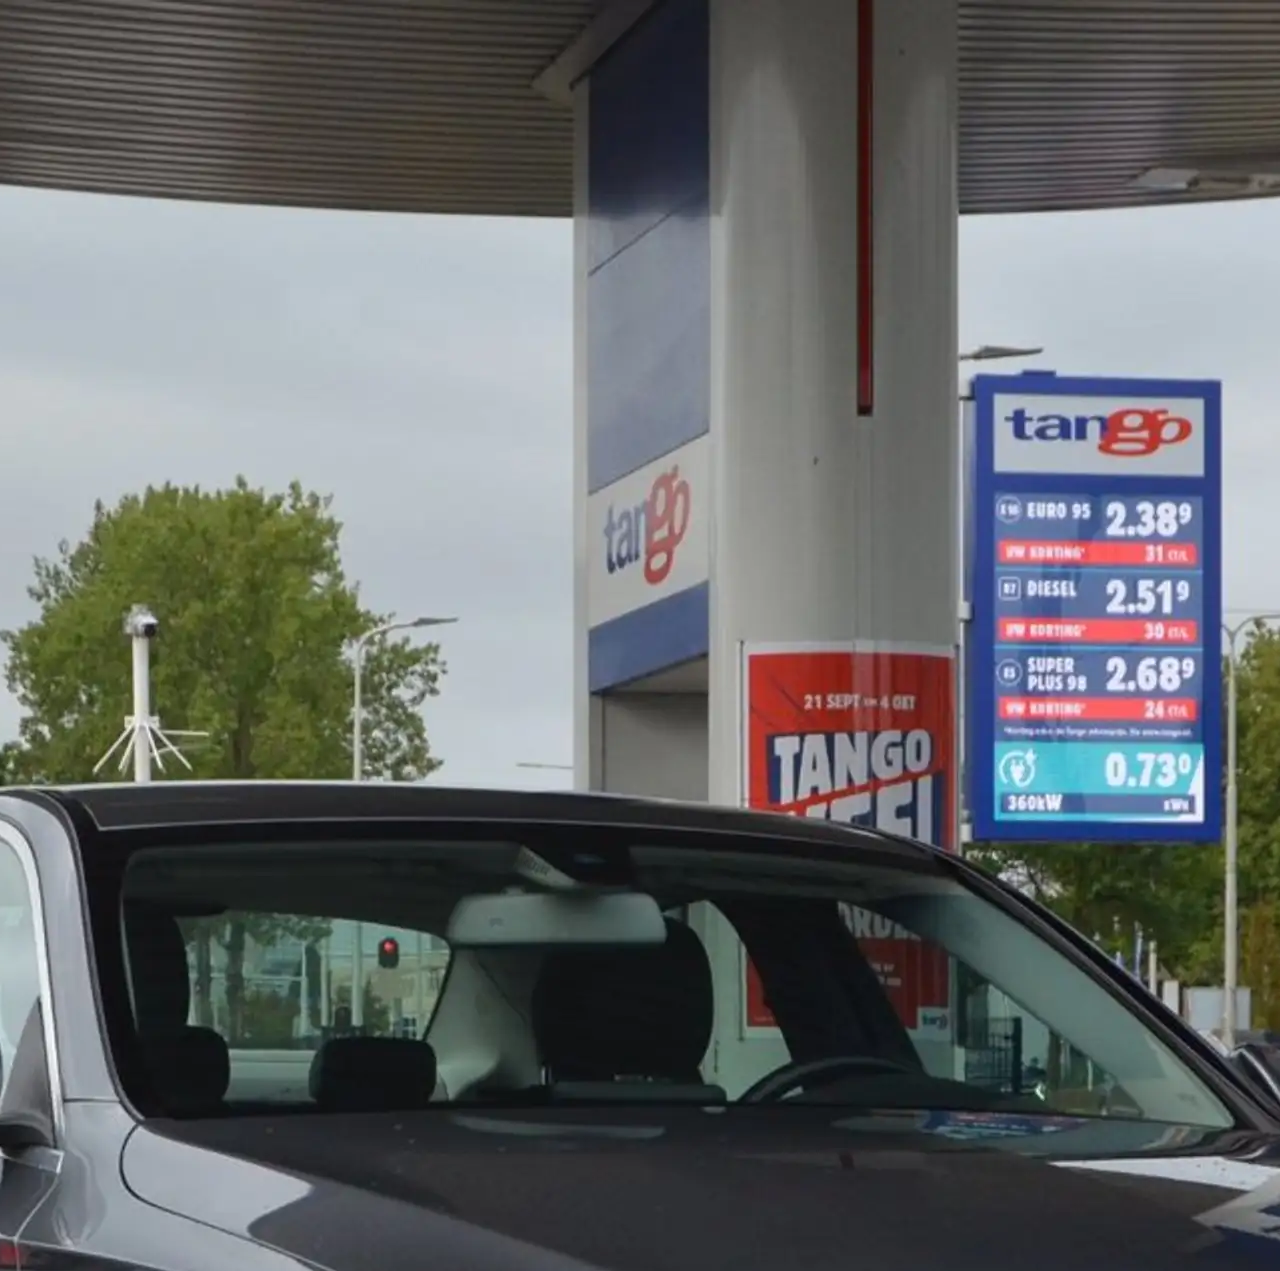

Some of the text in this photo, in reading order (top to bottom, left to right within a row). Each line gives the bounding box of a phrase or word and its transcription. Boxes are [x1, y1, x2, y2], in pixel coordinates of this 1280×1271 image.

[1005, 408, 1193, 457] tango
[1027, 502, 1067, 519] EURO
[1072, 503, 1091, 520] 95
[604, 464, 690, 585] tango
[1027, 580, 1077, 597] DIESEL
[1028, 657, 1074, 673] SUPER
[1028, 676, 1087, 691] PLUS 98
[804, 694, 822, 710] 21
[826, 694, 859, 712] SEPT
[774, 729, 931, 805] TANGO
